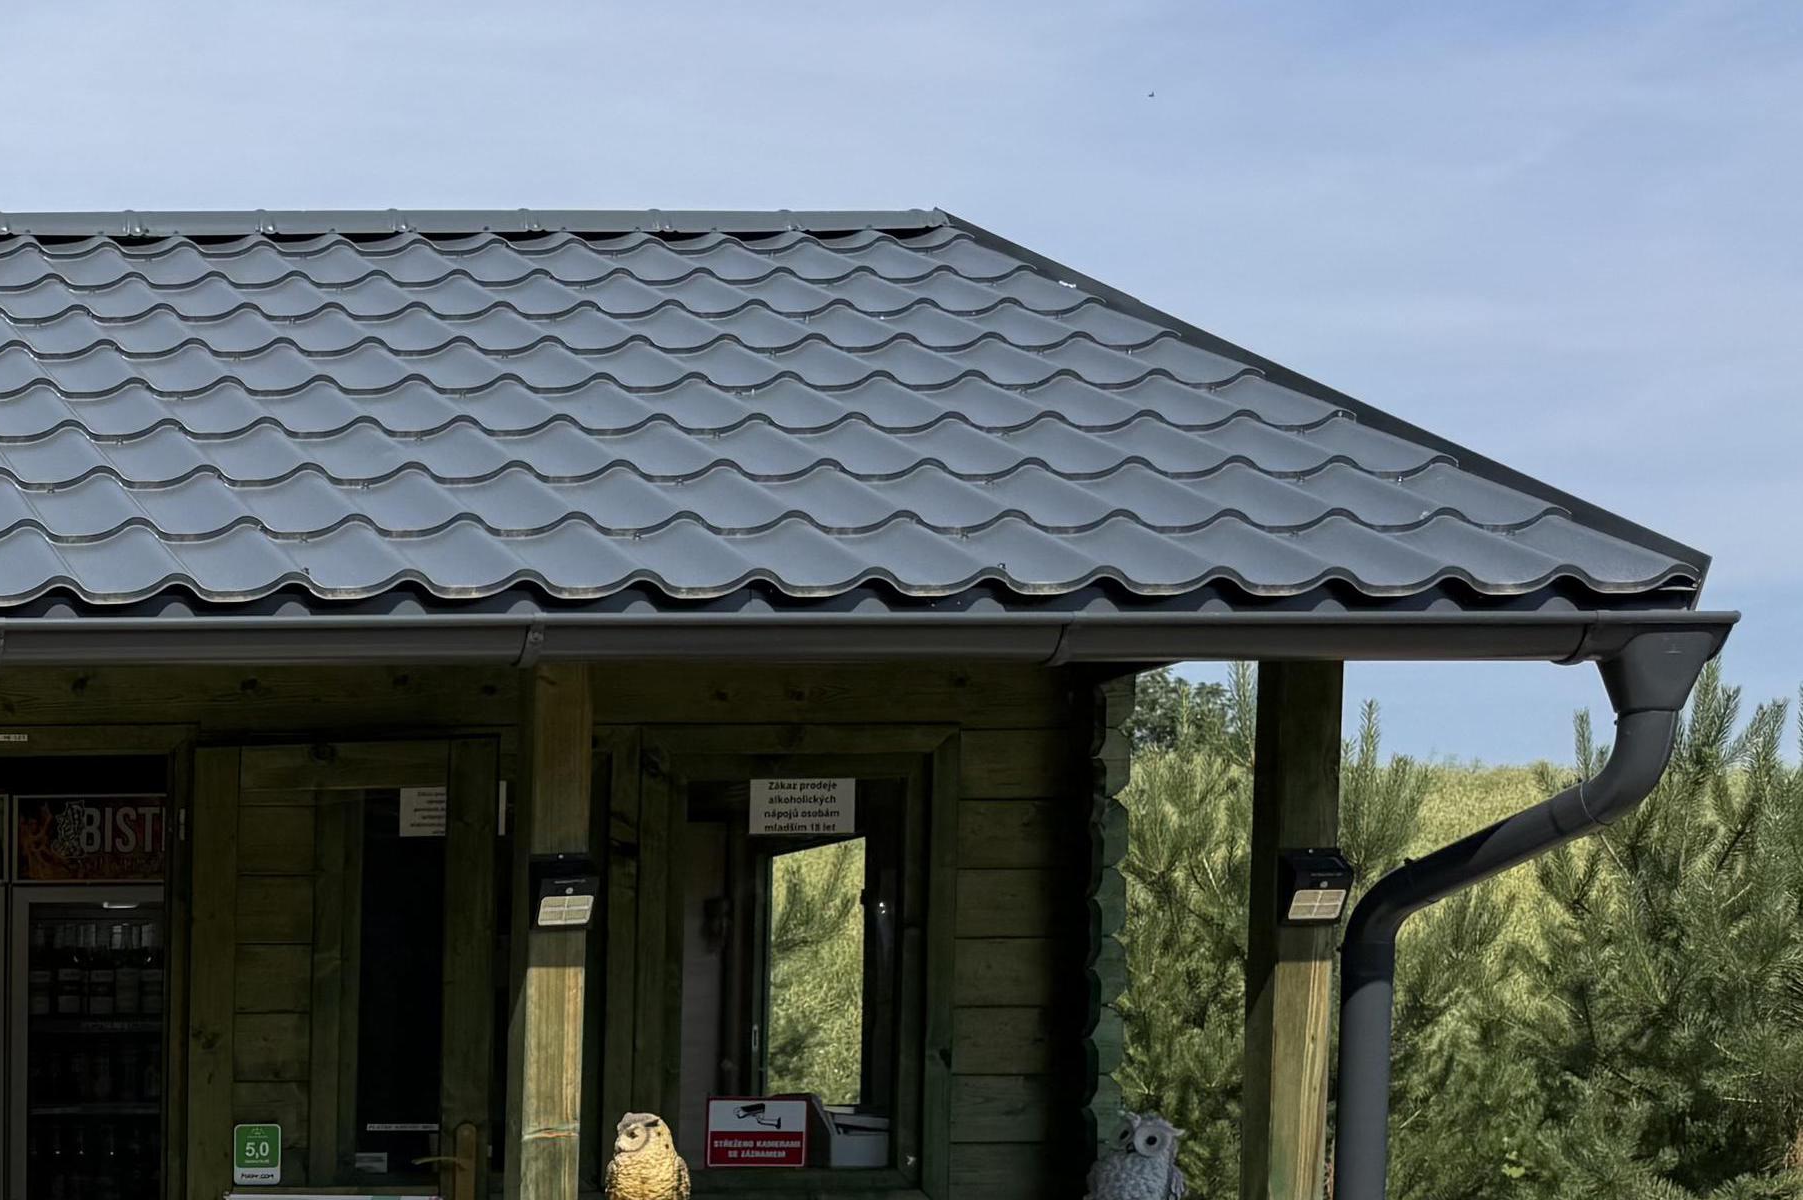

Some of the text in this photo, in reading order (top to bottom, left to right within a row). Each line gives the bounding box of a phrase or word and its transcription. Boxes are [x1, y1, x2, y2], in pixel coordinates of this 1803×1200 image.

[768, 780, 838, 793] Zákaz prodeje
[768, 794, 837, 806] alkoholických
[764, 807, 840, 820] nápojů osobám
[81, 806, 165, 853] BIST
[764, 821, 836, 832] mladším 18 let
[245, 1141, 270, 1160] 5,0
